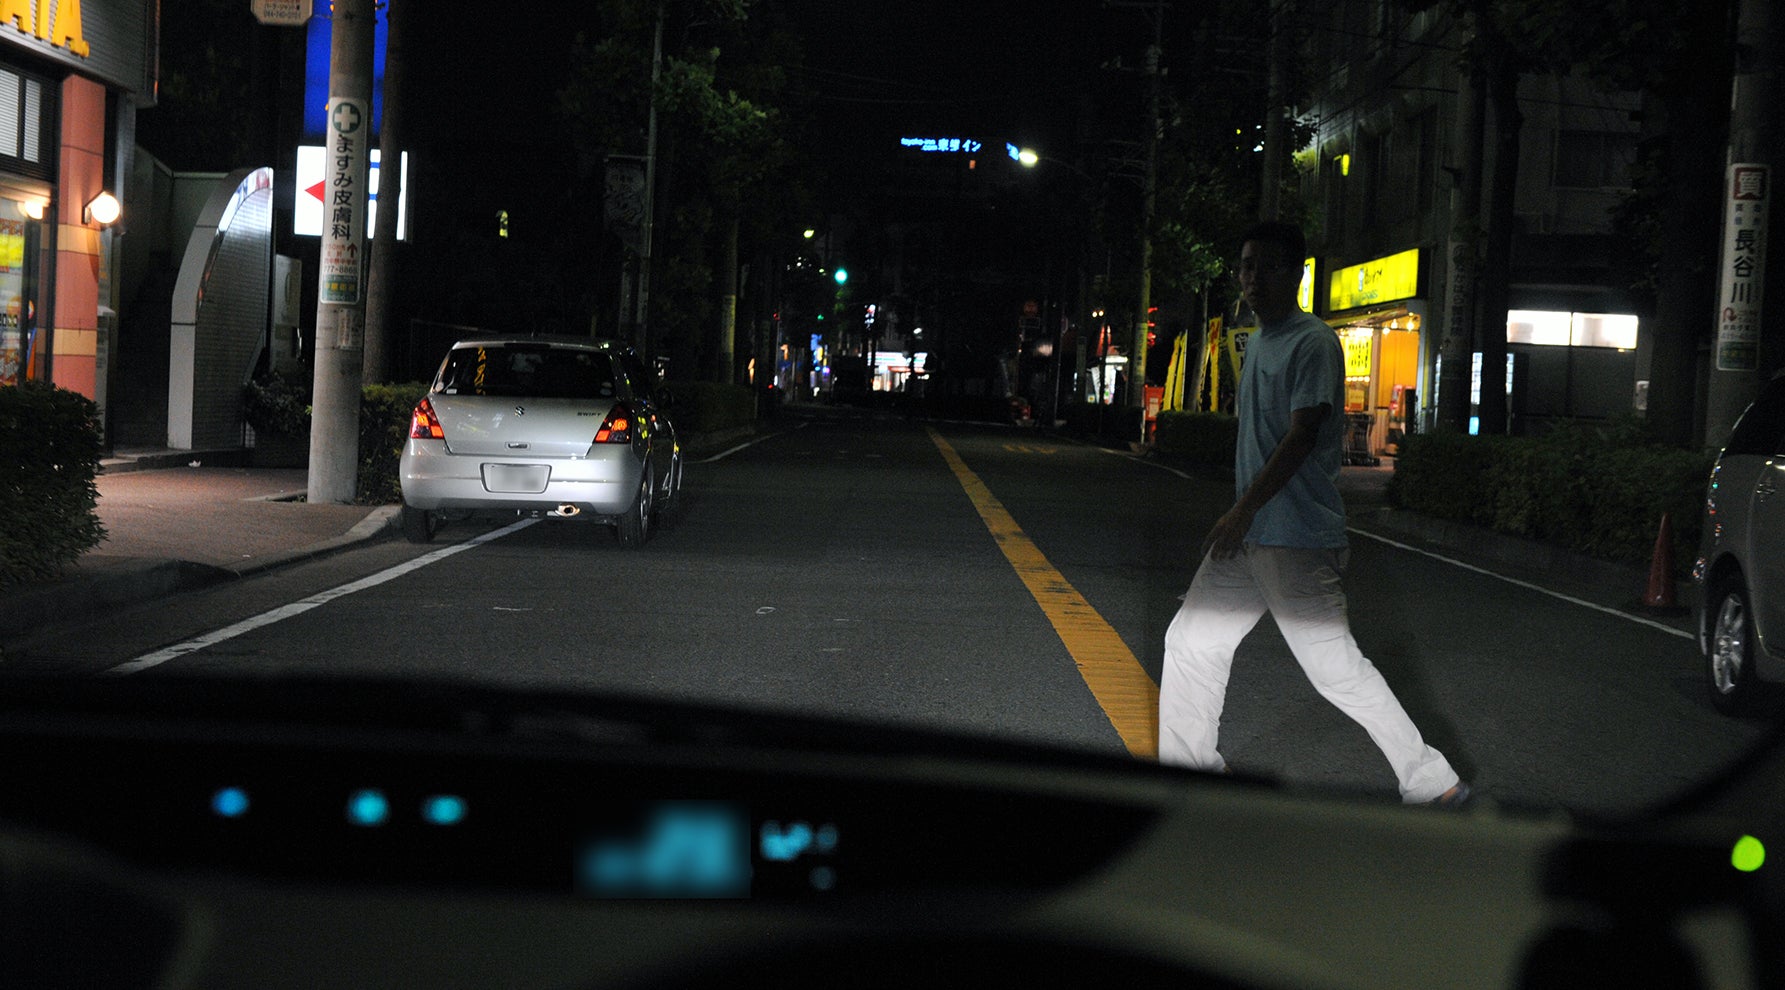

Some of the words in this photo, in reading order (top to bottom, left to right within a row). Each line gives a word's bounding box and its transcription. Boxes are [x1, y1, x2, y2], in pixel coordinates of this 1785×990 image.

[332, 134, 355, 242] ますみ皮膚科
[1731, 229, 1755, 304] 長谷川
